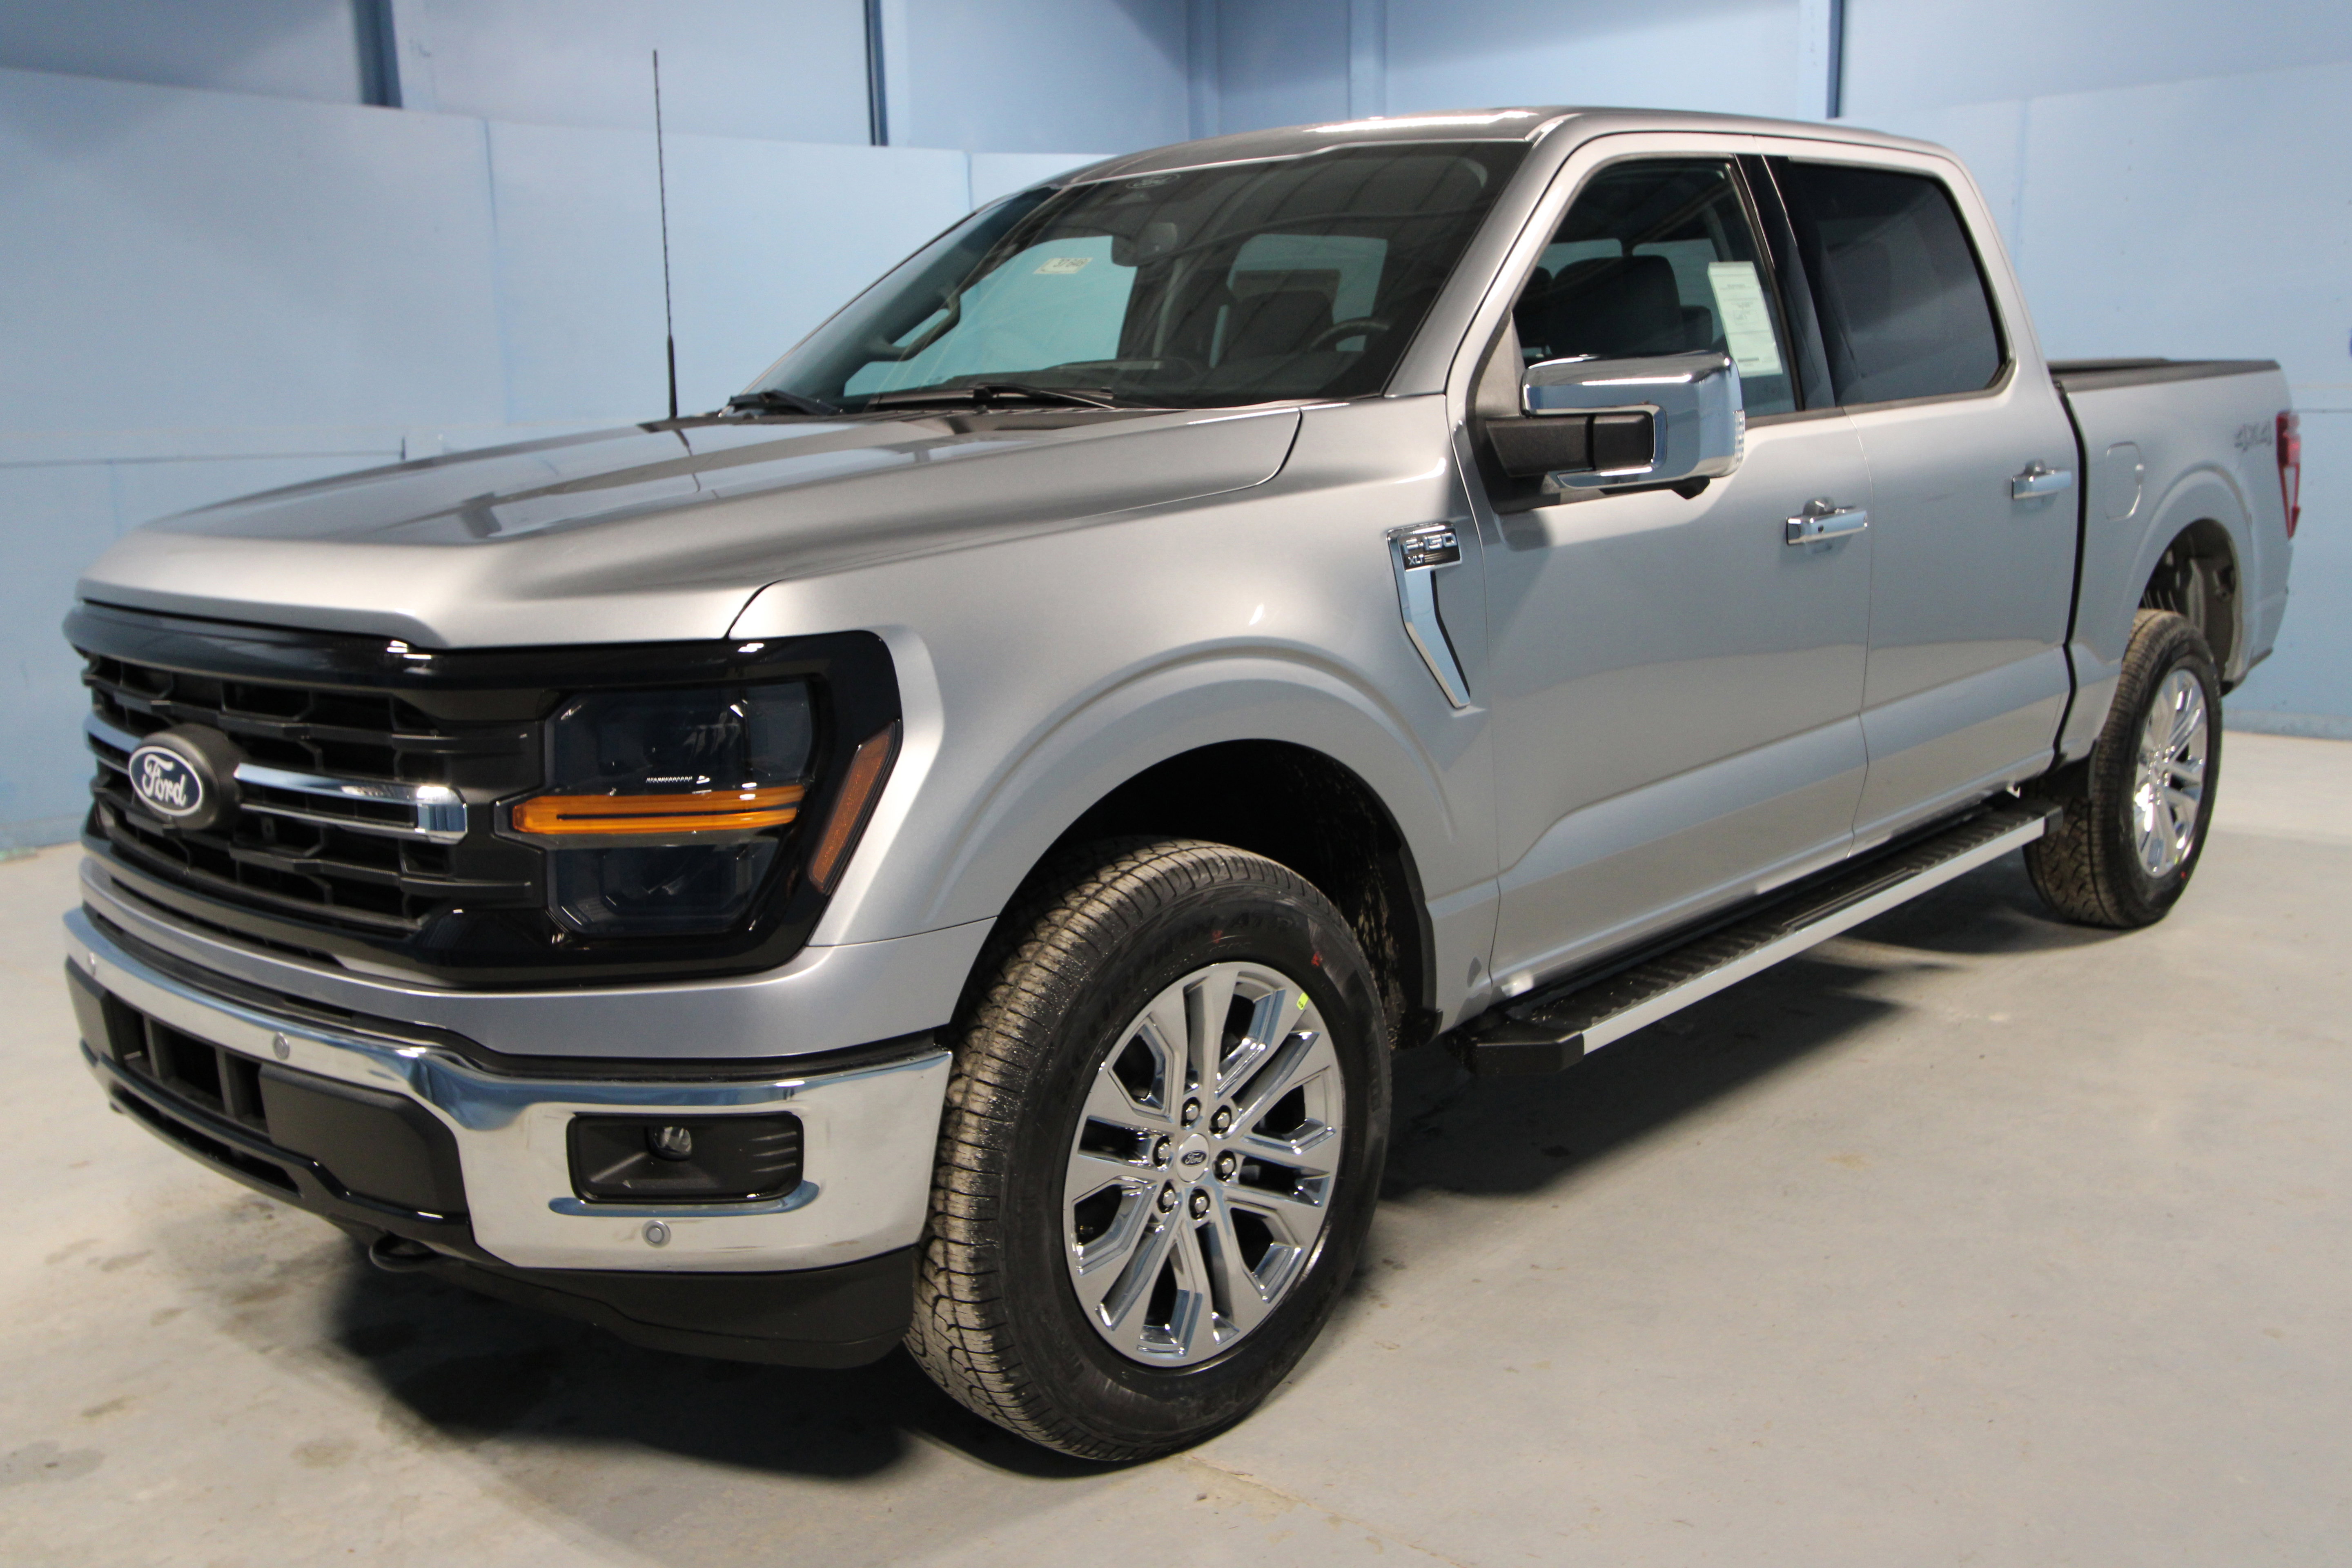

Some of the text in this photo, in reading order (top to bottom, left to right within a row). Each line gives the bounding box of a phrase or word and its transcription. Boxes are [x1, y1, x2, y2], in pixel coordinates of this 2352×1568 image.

[1402, 532, 1457, 554] F-150
[1408, 554, 1424, 565] XLT
[143, 754, 187, 806] Ford
[1185, 1153, 1203, 1164] Ford
